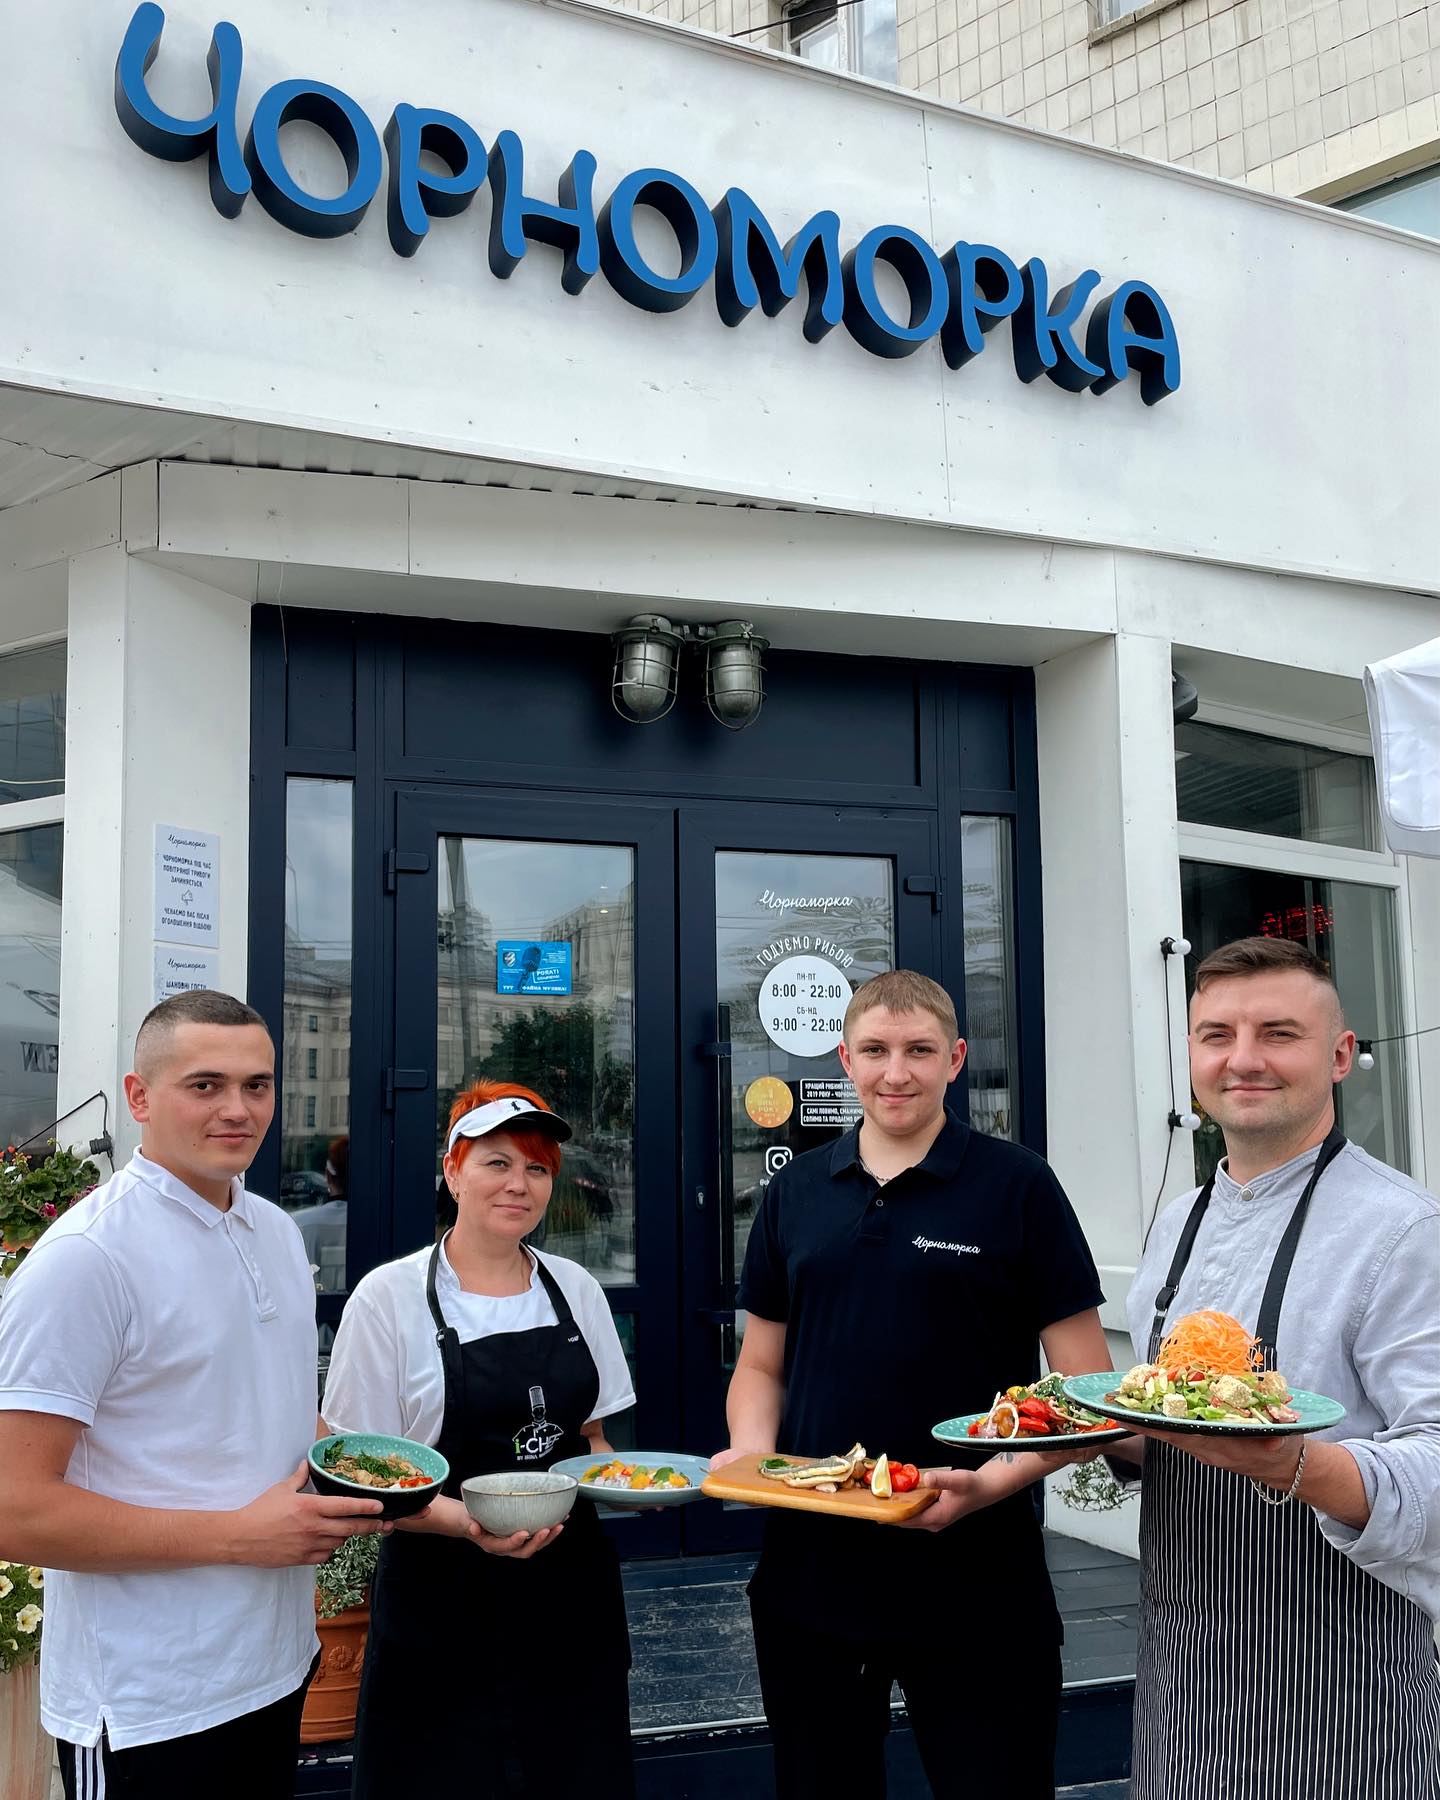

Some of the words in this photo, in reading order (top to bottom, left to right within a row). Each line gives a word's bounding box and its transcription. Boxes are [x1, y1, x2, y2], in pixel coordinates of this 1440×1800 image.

[113, 1, 1181, 406] ЧОРНОМОРКА
[163, 854, 193, 866] ЧОРНОМОРКА
[203, 862, 212, 870] ЧАС
[760, 890, 853, 916] Чорноморка
[164, 907, 186, 917] ЧЕКАЄМО
[756, 935, 810, 967] ГОДУЄМО
[815, 937, 854, 969] РИБОЮ
[772, 984, 797, 997] 8:00
[810, 984, 842, 999] 22:00
[772, 1017, 797, 1031] 9:00
[811, 1018, 842, 1032] 22:00
[819, 1090, 831, 1098] РОКУ
[911, 1235, 981, 1256] Чорноморка
